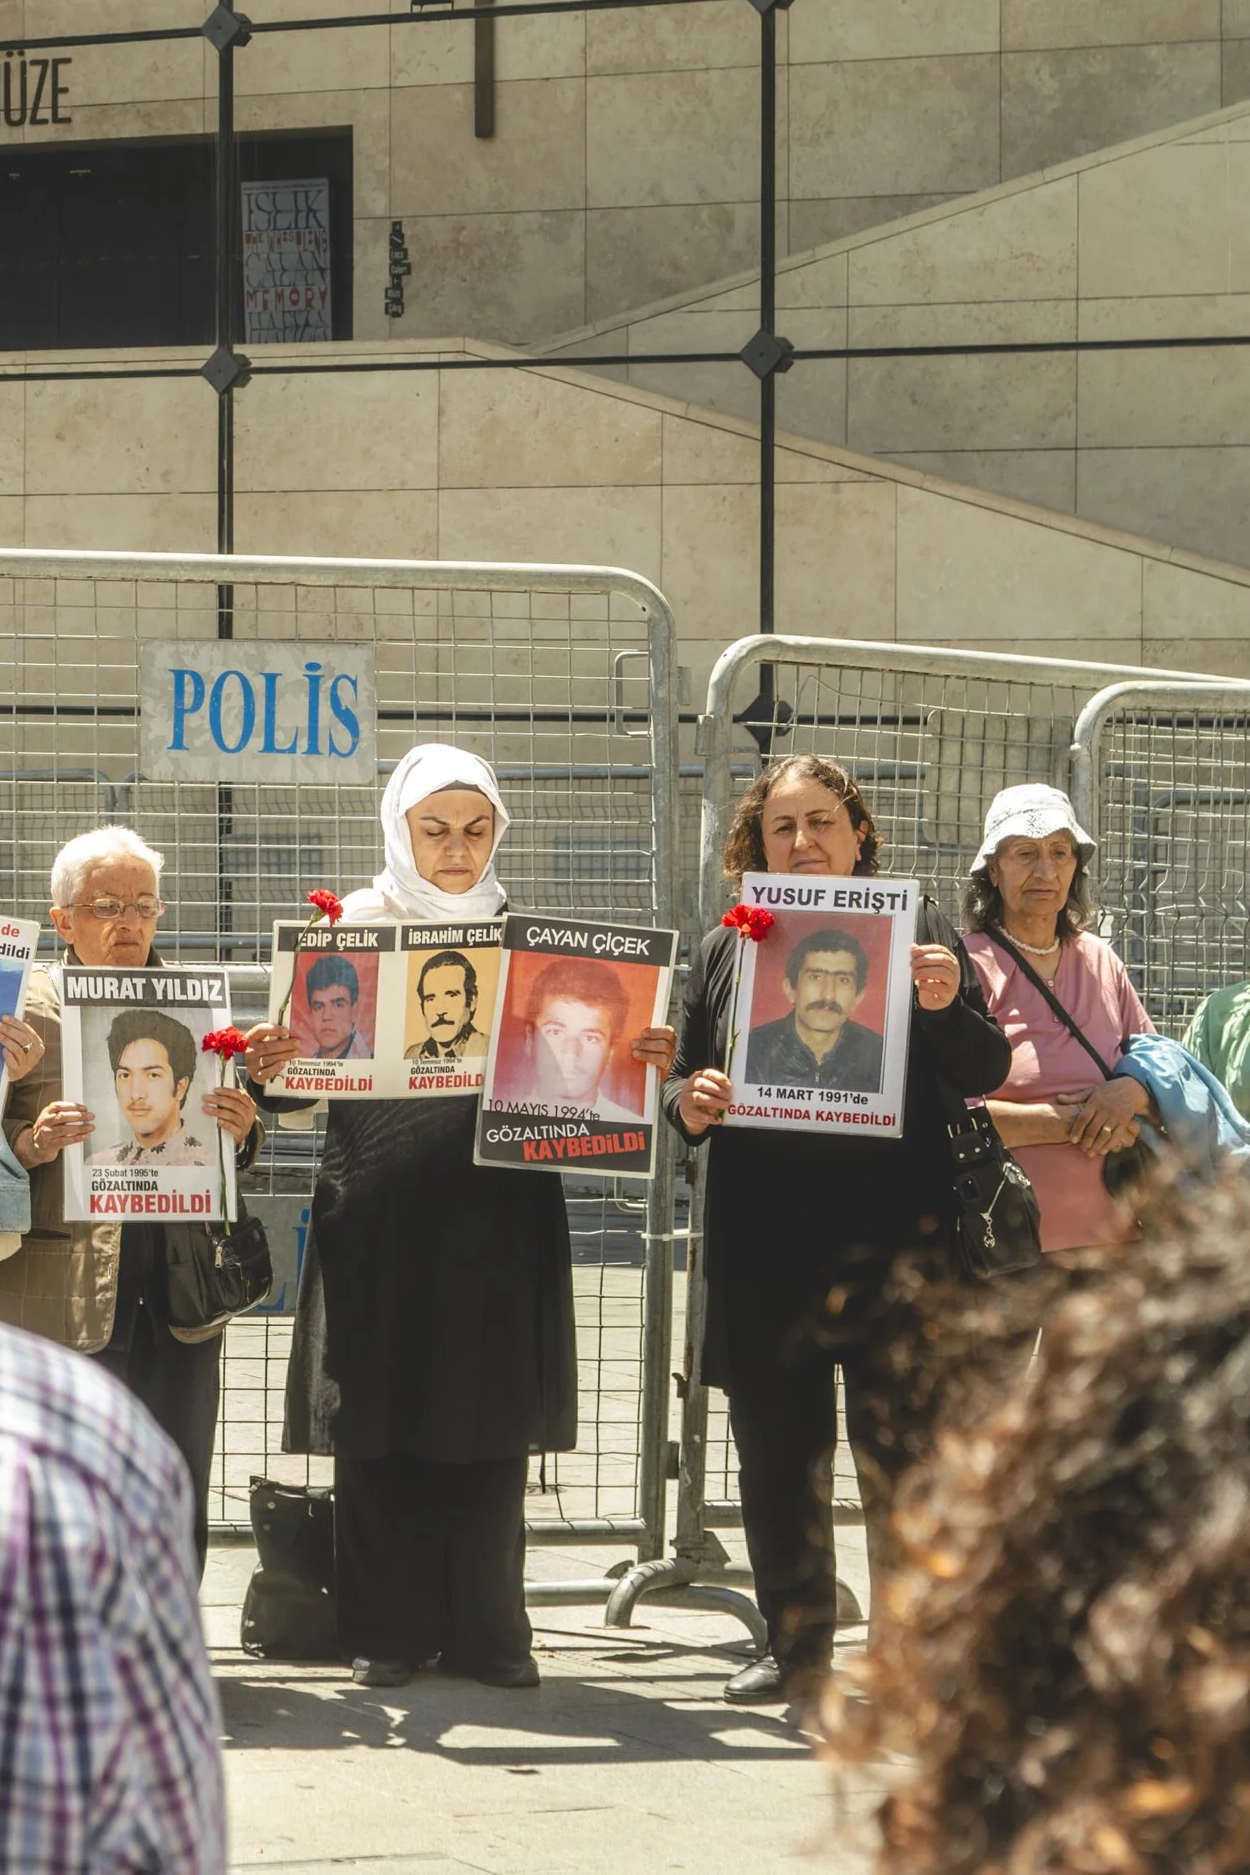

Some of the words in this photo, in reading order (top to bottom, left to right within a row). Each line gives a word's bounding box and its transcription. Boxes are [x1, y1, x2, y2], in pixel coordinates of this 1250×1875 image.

[246, 286, 328, 312] MEMORY
[166, 661, 361, 759] POLİS
[752, 886, 826, 907] YUSUF
[833, 887, 908, 914] ERİŞTİ
[1, 924, 20, 938] de
[298, 929, 332, 947] EDİP
[336, 929, 379, 950] ÇELİK
[408, 926, 463, 945] İBRAHİM
[467, 925, 502, 948] ÇELİK
[526, 926, 589, 949] ÇAYAN
[592, 932, 651, 956] ÇİÇEK
[67, 976, 146, 1001] MURAT
[151, 977, 223, 1002] YILDIZ
[287, 1066, 336, 1076] GÖZALTINDA
[297, 1059, 321, 1067] Temmuz
[411, 1064, 455, 1075] GÖZALTINDA
[285, 1074, 373, 1092] KAYBEDİLDİ
[409, 1071, 483, 1090] KAYBEDİLD
[757, 1087, 772, 1098] 14
[776, 1088, 814, 1101] MART
[819, 1091, 869, 1105] 1991'de
[488, 1098, 504, 1111] 10
[506, 1101, 549, 1117] MAYIS
[554, 1105, 600, 1121] 1994'te
[727, 1103, 811, 1121] GÖZALTINDA
[815, 1110, 897, 1127] KAYBEDİLDİ
[486, 1123, 590, 1143] GÖZALTINDA
[92, 1169, 102, 1177] 23
[104, 1168, 128, 1179] Şubat
[91, 1179, 159, 1192] GÖZALTINDA
[90, 1189, 211, 1214] KAYBEDİLDİ
